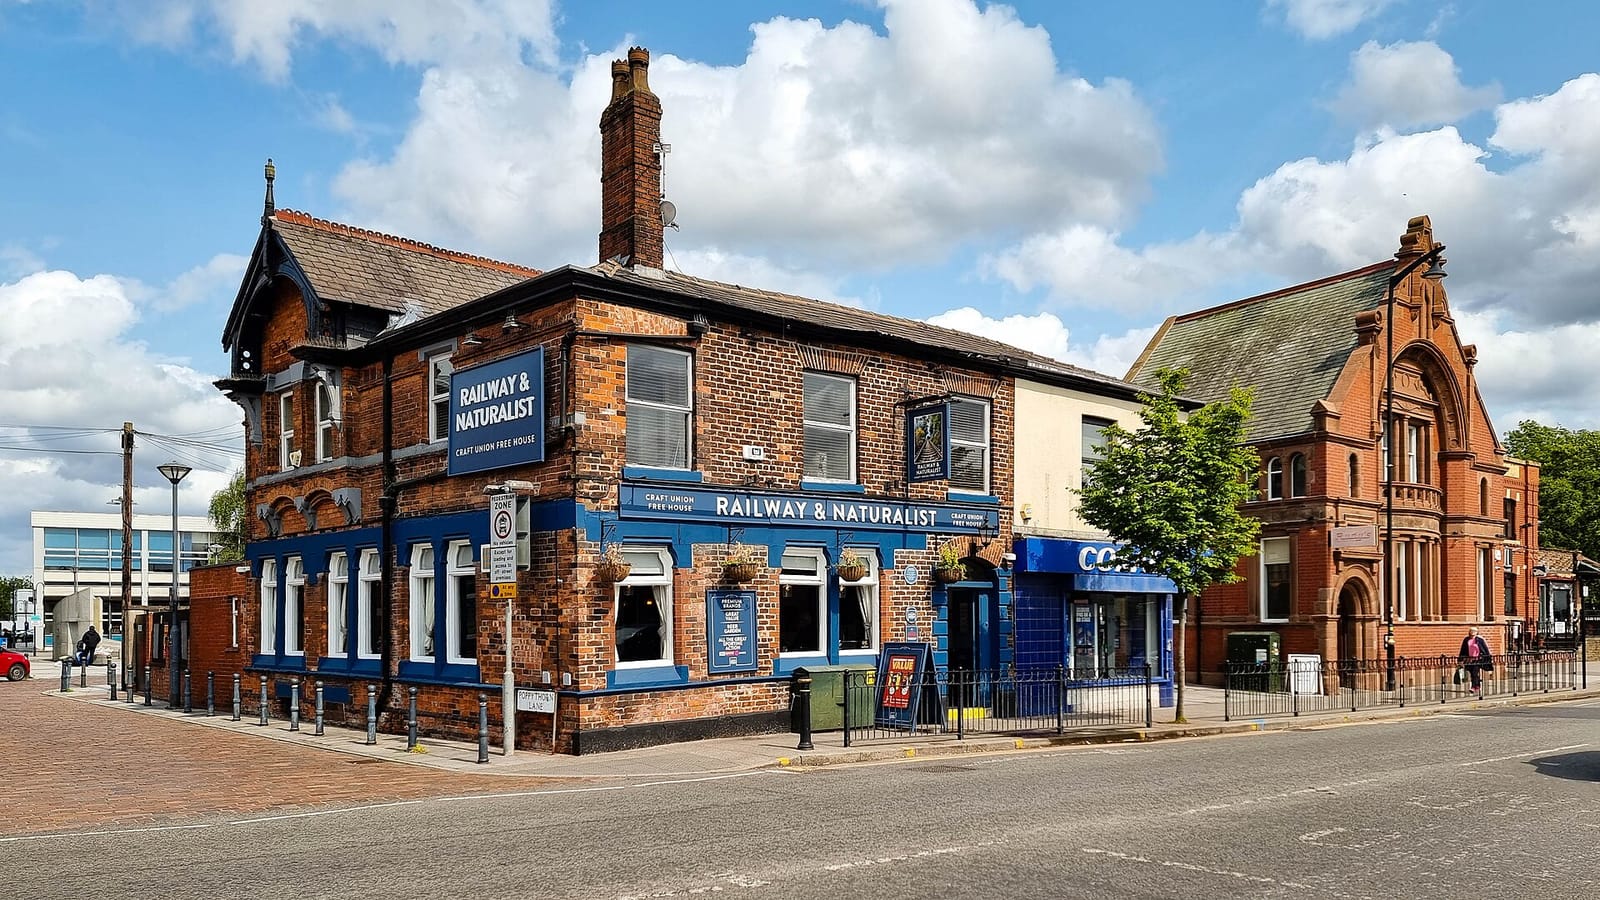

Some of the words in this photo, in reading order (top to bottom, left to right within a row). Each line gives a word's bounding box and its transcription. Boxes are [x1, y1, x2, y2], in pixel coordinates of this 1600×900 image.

[460, 374, 518, 407] RAILWAY
[519, 371, 530, 392] &
[455, 396, 535, 432] NATURALIST
[455, 446, 474, 457] CRAFT
[474, 442, 495, 453] UNION
[496, 438, 512, 449] FREE
[513, 434, 536, 444] HOUSE
[491, 494, 515, 502] PEDESTRIAN
[645, 493, 669, 502] CRAFT
[670, 494, 695, 503] UNION
[494, 501, 512, 510] ZONE
[648, 502, 667, 511] FREE
[668, 504, 693, 512] HOUSE
[716, 496, 808, 519] RAILWAY
[814, 502, 827, 521] &
[833, 503, 937, 527] NATURALIST
[892, 661, 914, 670] VALUE
[528, 701, 544, 711] LANE
